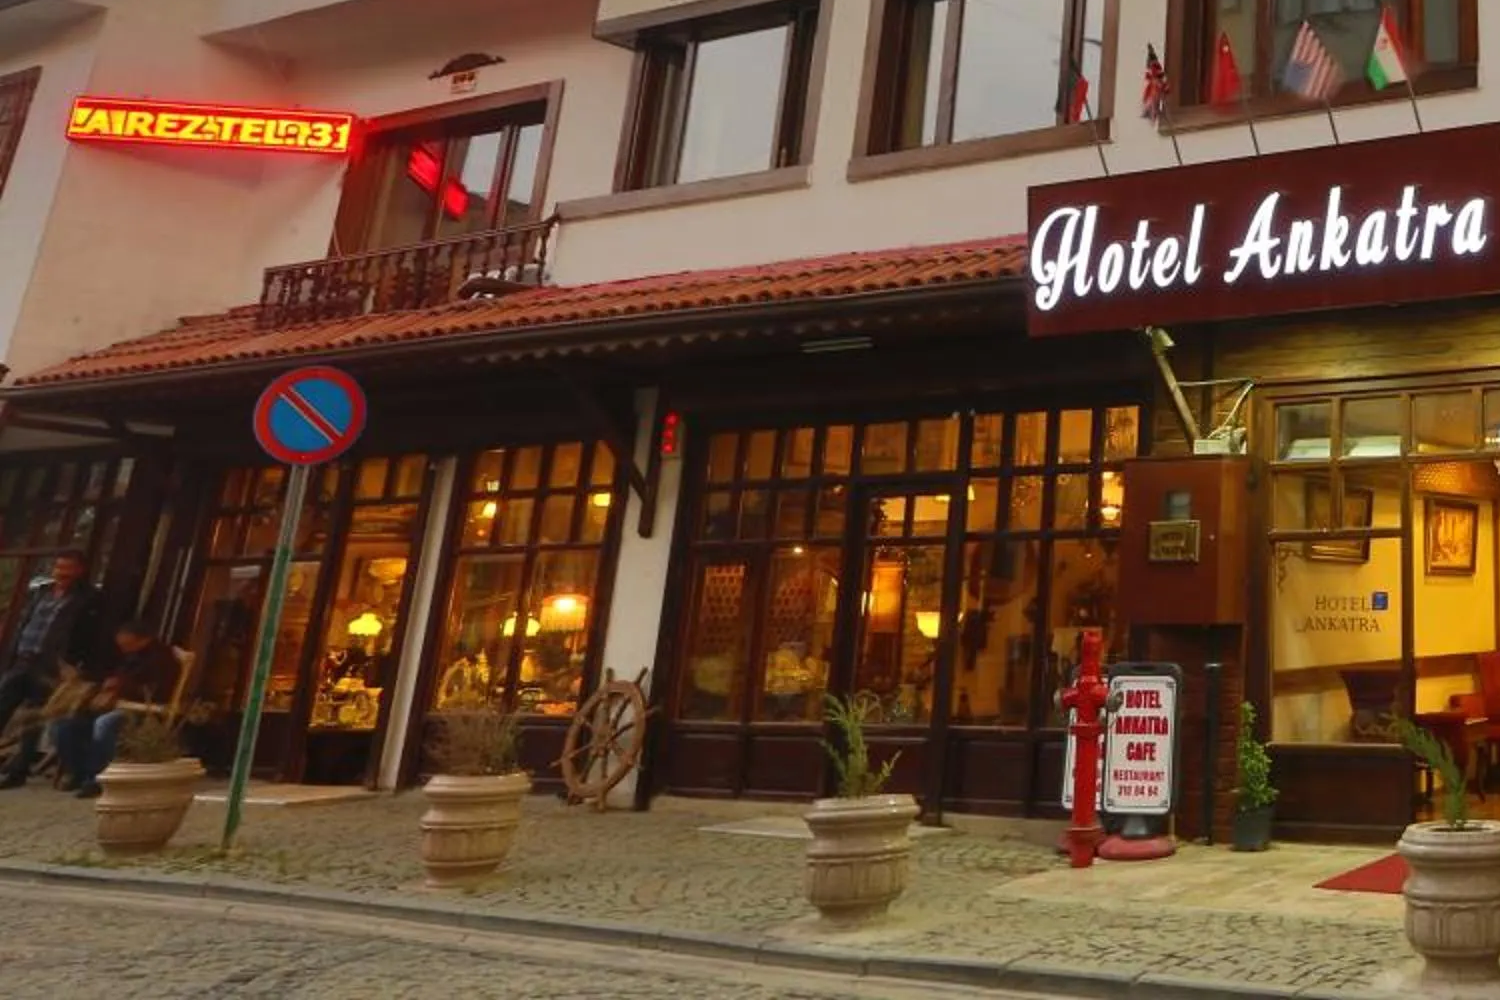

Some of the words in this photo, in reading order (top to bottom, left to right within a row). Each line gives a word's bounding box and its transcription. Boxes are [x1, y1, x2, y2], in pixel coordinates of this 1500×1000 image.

[1030, 203, 1206, 311] Hotel
[1223, 185, 1490, 284] Ankatra
[1296, 615, 1381, 633] ANKATRA
[1125, 689, 1162, 709] HOTEL
[1115, 715, 1169, 735] ANKATRA
[1126, 742, 1157, 762] CAFE
